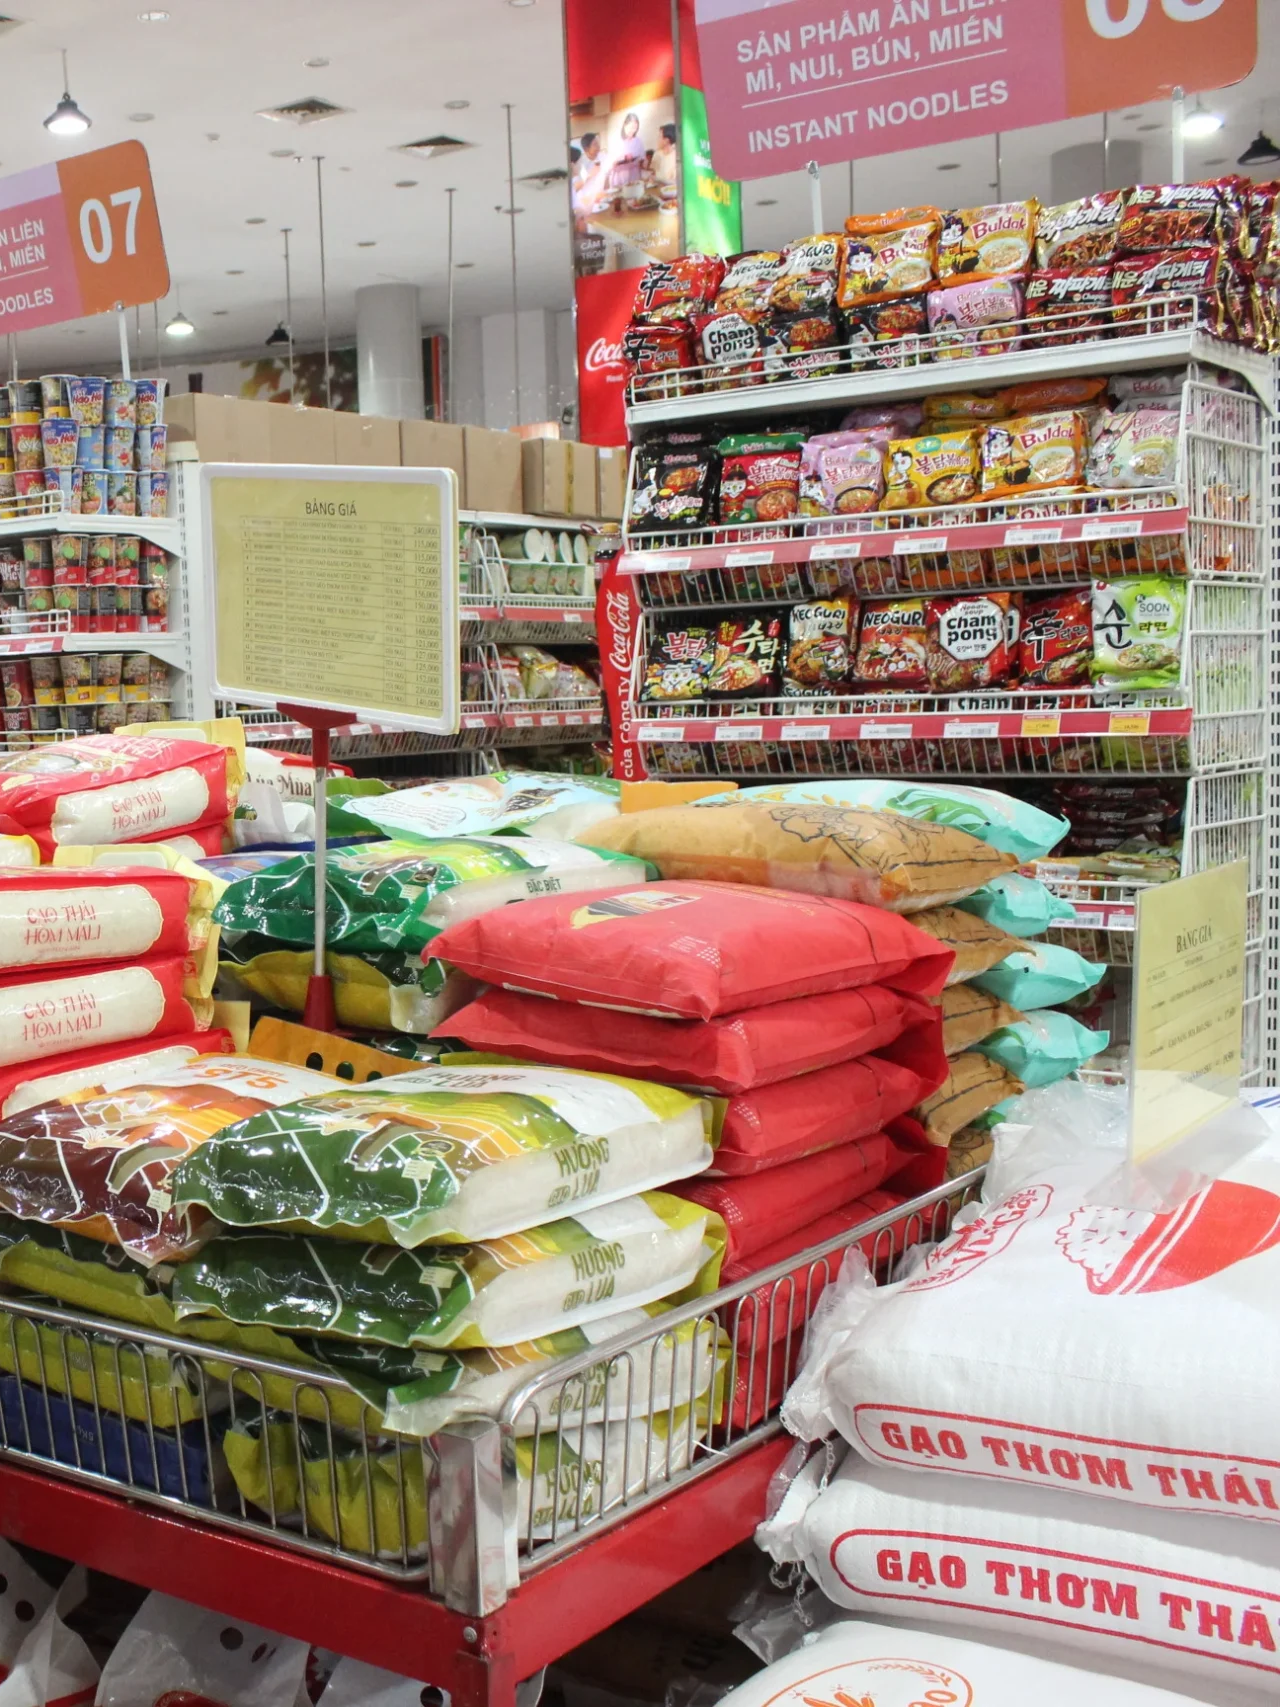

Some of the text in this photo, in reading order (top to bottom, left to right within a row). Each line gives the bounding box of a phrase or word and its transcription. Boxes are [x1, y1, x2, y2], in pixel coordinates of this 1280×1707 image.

[736, 29, 793, 64] SẢN
[799, 8, 882, 51] PHẨM
[745, 15, 1004, 95] MÌ, NUI, BÚN, MIẾN
[747, 79, 1010, 154] INSTANT NOODLES
[78, 185, 143, 266] 07
[972, 215, 1028, 240] Buldak
[304, 498, 358, 517] BẢNG GIÁ
[861, 609, 926, 629] NEOGURI
[1093, 598, 1134, 650] 순
[1137, 620, 1169, 634] 라면
[1138, 601, 1171, 615] SOON
[946, 628, 998, 647] pong
[620, 747, 634, 780] của
[525, 878, 545, 896] ĐẶC
[553, 1136, 611, 1179] HƯƠNG
[570, 1240, 627, 1283] HƯƠNG
[879, 1420, 1280, 1511] GẠO THƠM THÁI
[875, 1547, 1280, 1653] GẠO THƠM THÁ
